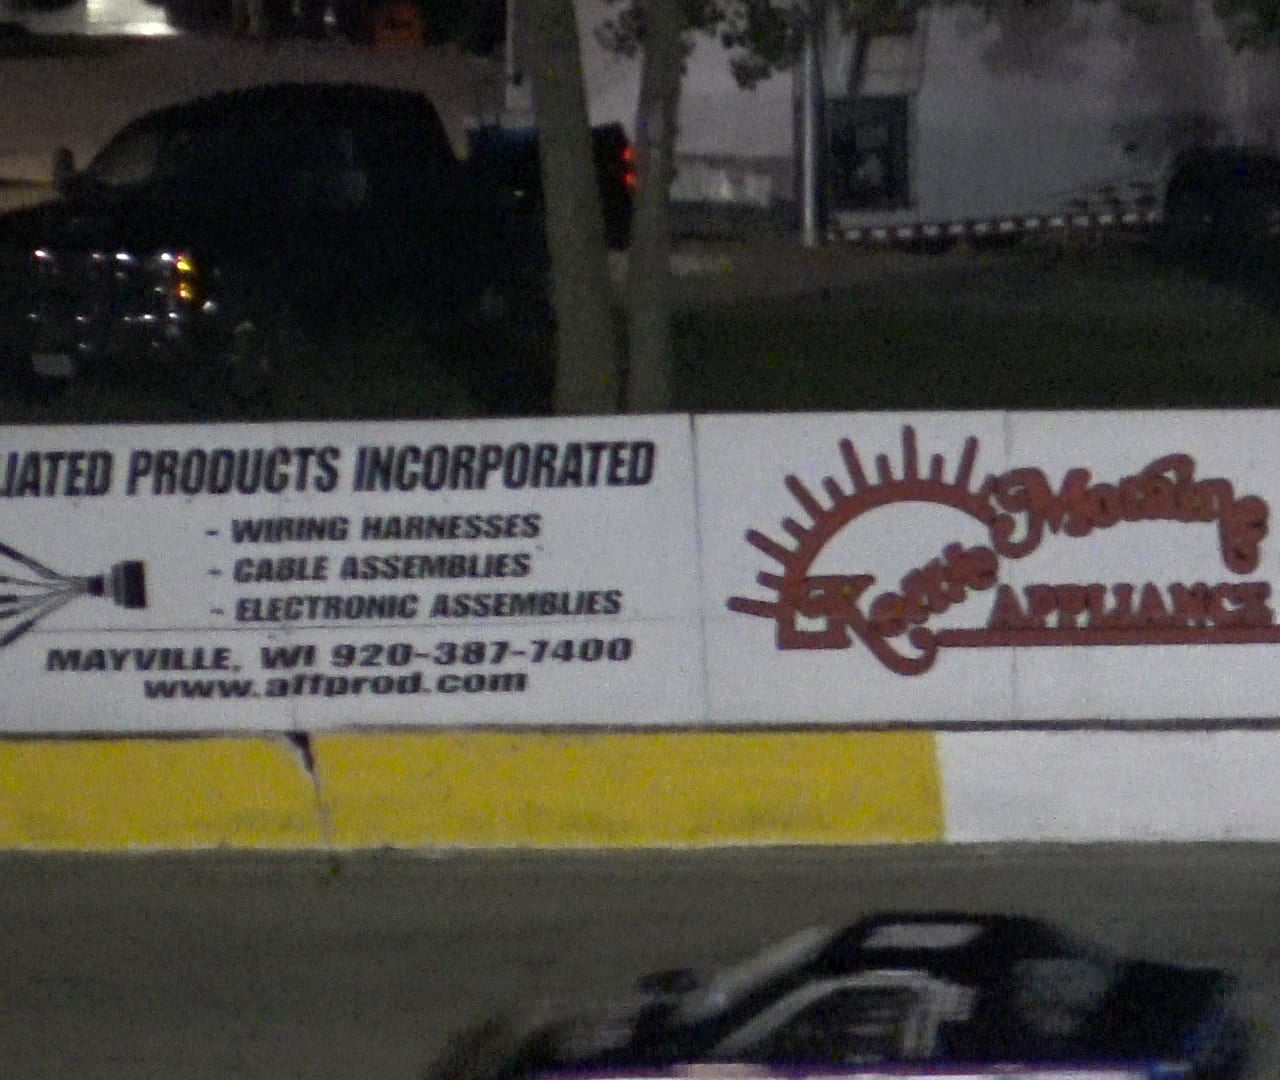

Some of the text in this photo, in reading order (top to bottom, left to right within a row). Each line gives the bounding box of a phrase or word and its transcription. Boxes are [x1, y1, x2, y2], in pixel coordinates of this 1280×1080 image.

[126, 445, 341, 497] PRODUCTS
[353, 440, 656, 492] INCORPORATED
[231, 513, 542, 544] WIRING HARNESSES
[233, 552, 531, 584] CABLE ASSEMBLIES
[235, 589, 623, 624] ELECTRONIC ASSEMBLIES
[261, 644, 316, 670] WI
[331, 637, 633, 669] 920-387-7400
[145, 670, 527, 700] www.affprod.com
